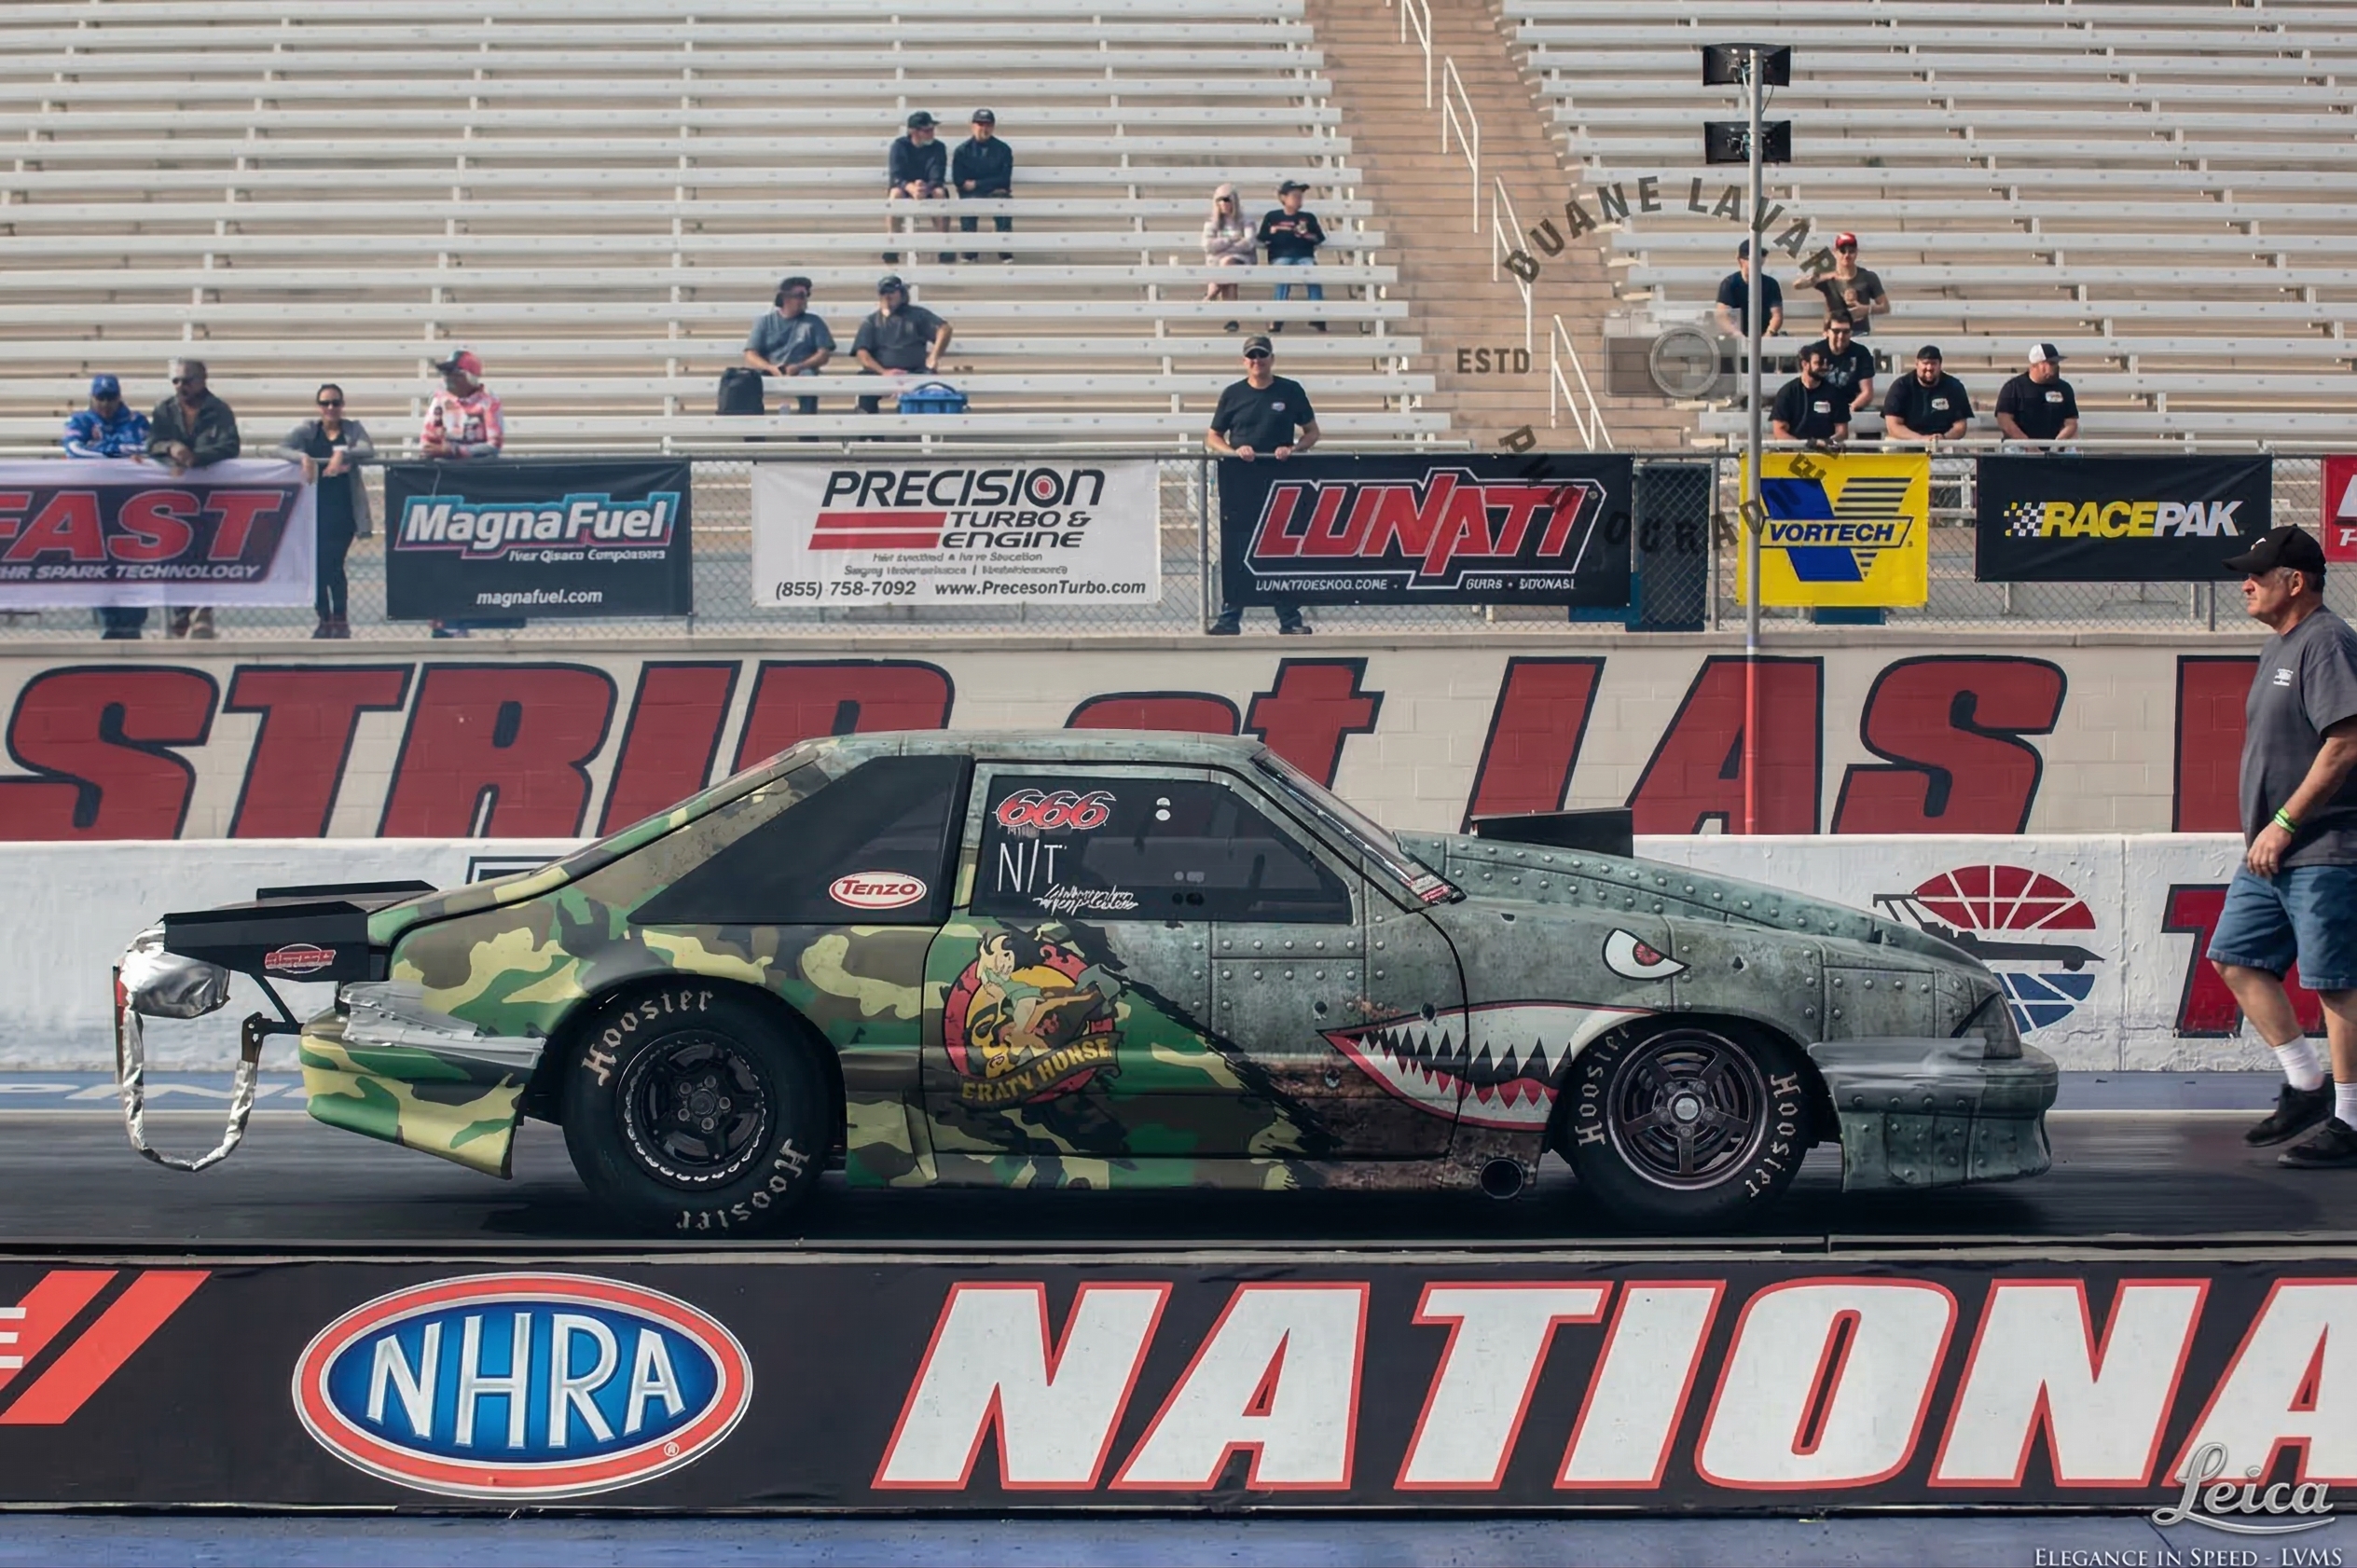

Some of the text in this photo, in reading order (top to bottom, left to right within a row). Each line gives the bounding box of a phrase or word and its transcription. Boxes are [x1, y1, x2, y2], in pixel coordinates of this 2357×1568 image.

[950, 510, 1093, 529] TURBO &
[1253, 473, 1591, 576] LUNATI
[2039, 501, 2243, 539] RACEPAK
[1770, 523, 1895, 543] VORTECH
[35, 564, 111, 580] SPARK
[116, 564, 260, 580] TECHNOLOGY
[476, 588, 603, 607] magnafuel.com
[775, 580, 823, 600] (855)
[830, 580, 917, 598] 758-7092
[992, 789, 1116, 831] 666
[365, 1277, 2357, 1492] NHRA NATIONA
